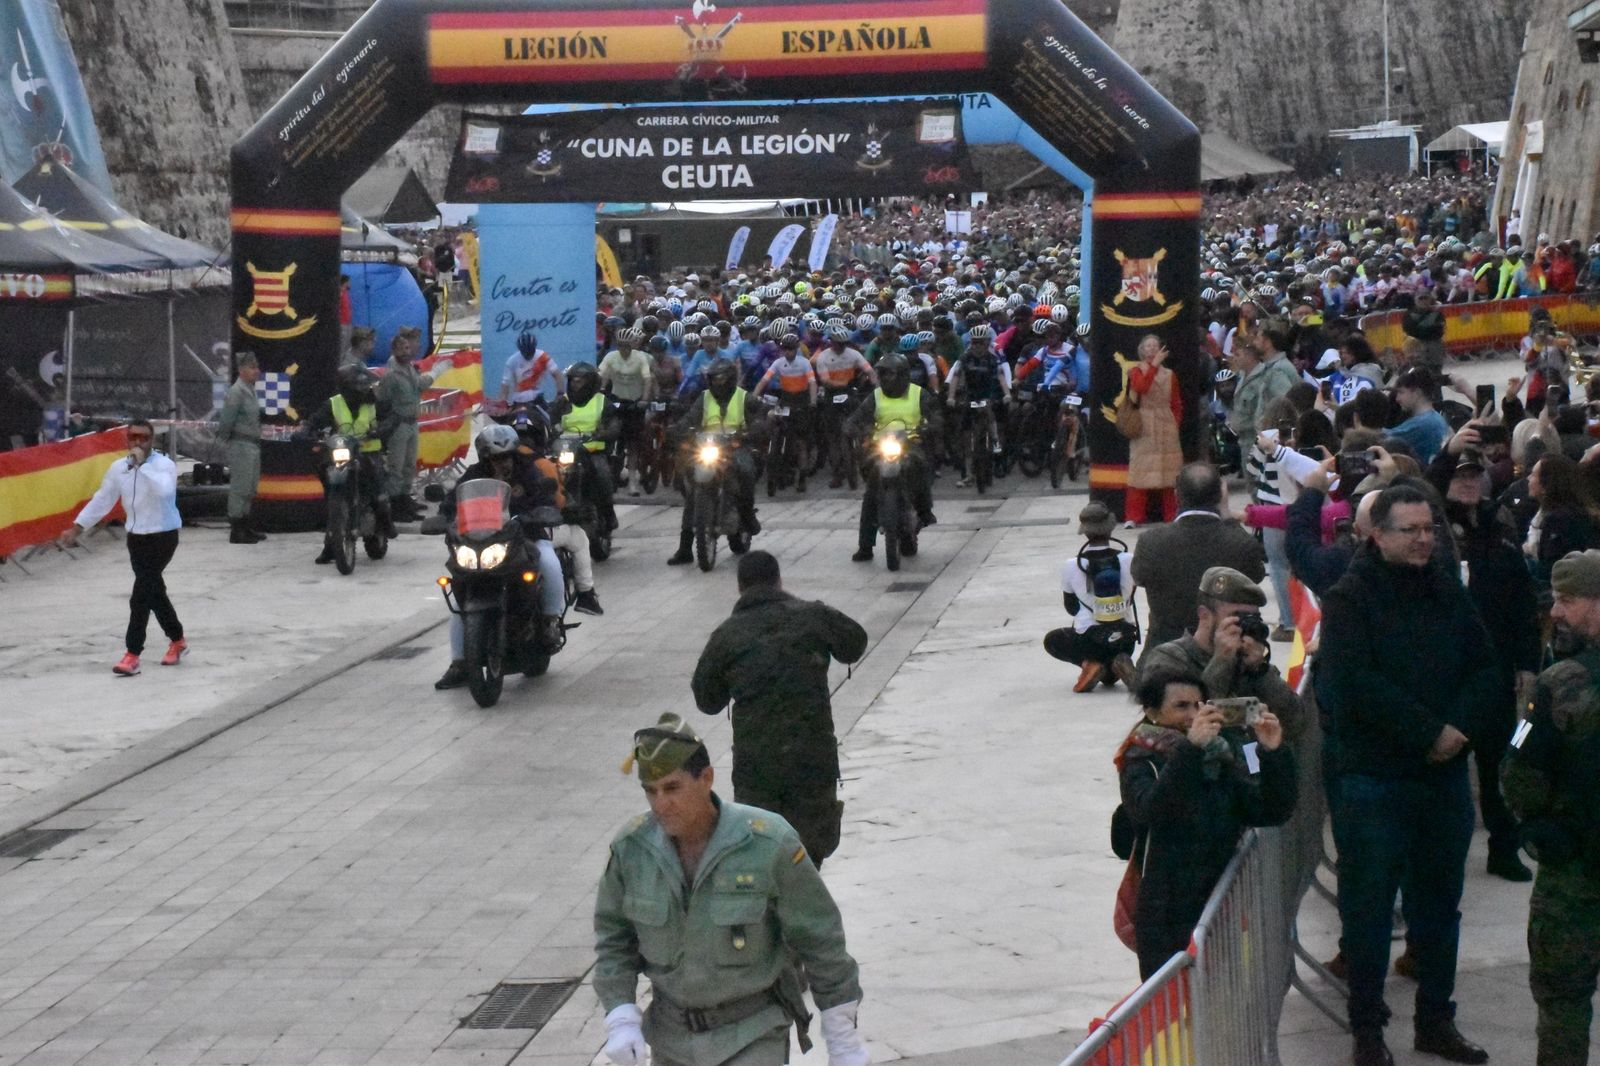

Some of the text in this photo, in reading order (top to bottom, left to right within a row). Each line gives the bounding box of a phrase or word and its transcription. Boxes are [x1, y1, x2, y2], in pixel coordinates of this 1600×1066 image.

[503, 23, 932, 60] LEGIÓN ESPAÑOLA
[267, 105, 311, 144] spíritu
[311, 84, 326, 106] del
[330, 38, 378, 85] egionario
[1082, 66, 1097, 80] de
[1094, 77, 1109, 91] la
[637, 113, 780, 127] CARRERA CÍVICO-MILITAR
[662, 137, 694, 157] DE
[702, 136, 732, 156] LA
[661, 163, 755, 189] CEUTA
[0, 273, 45, 298] VO
[491, 273, 579, 300] Ceuta es
[494, 307, 581, 334] Deporte
